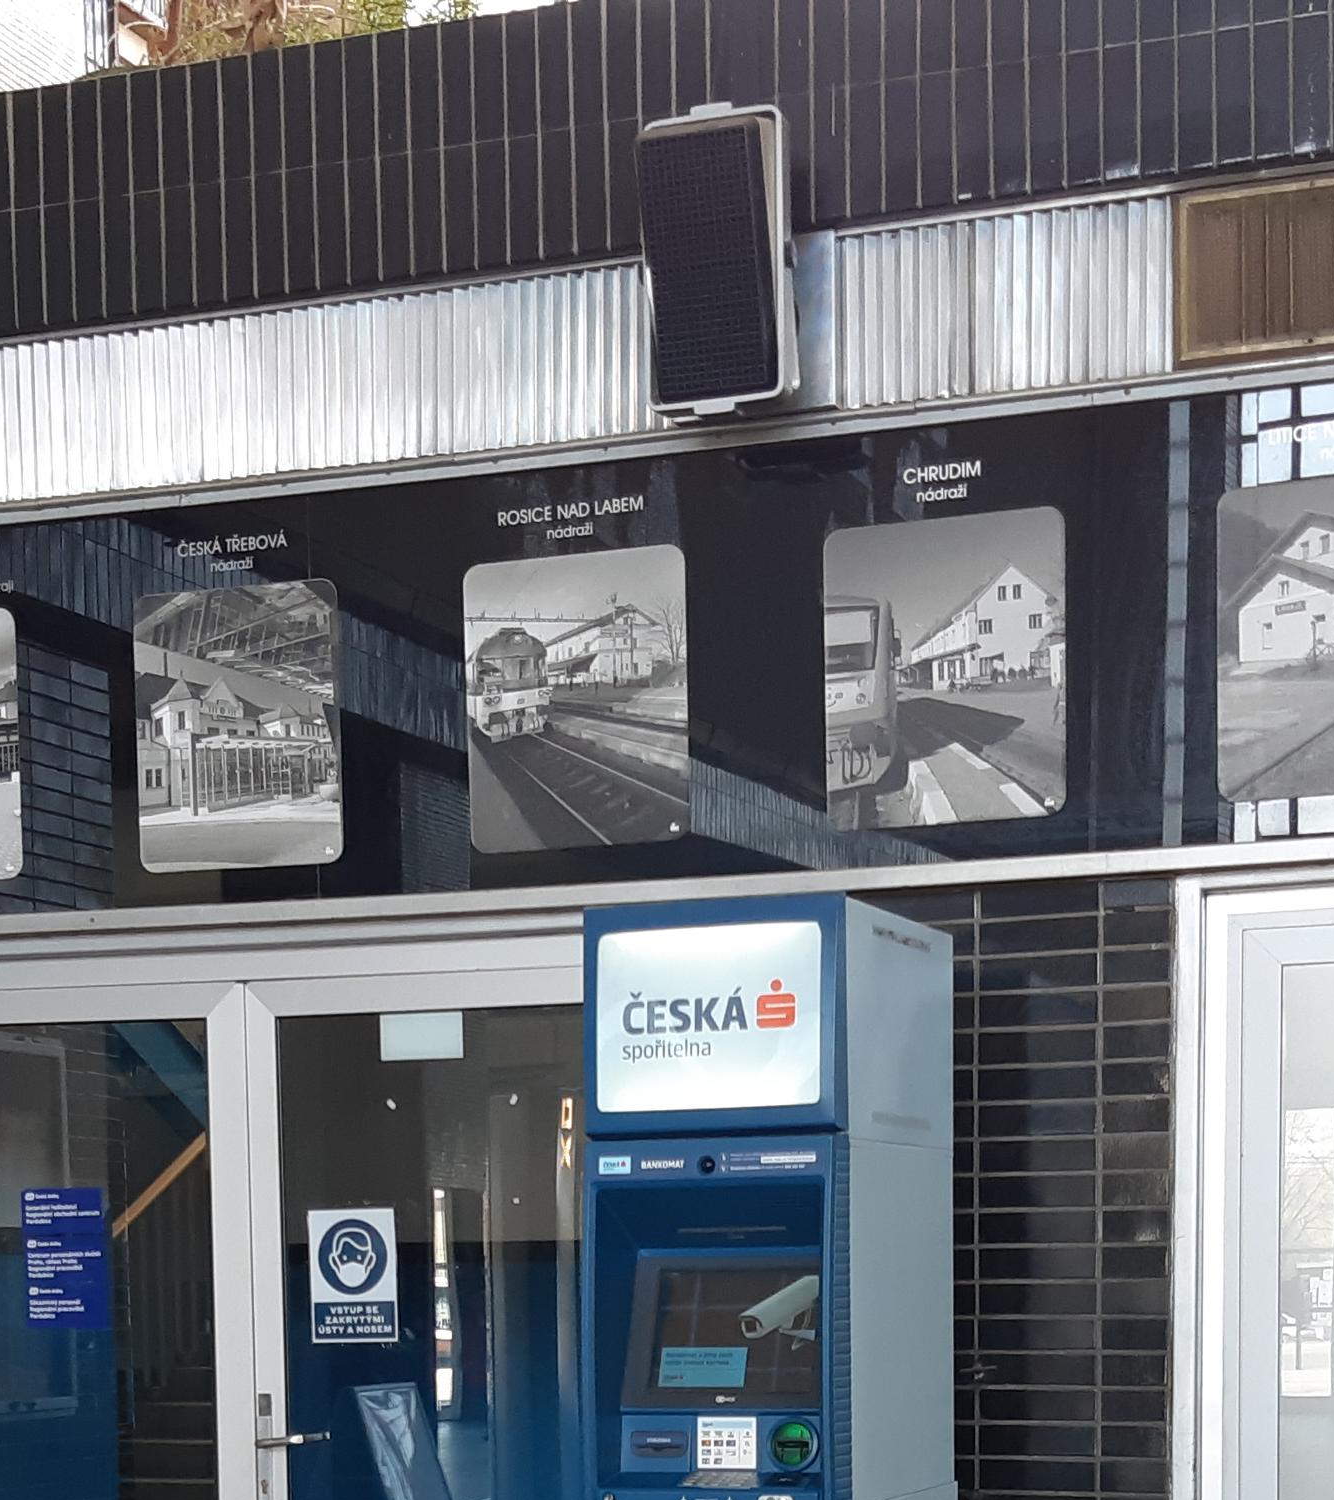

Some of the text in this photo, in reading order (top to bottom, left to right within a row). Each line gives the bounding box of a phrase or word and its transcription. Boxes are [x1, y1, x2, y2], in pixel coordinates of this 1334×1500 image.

[903, 460, 982, 485] CHRUDIM
[916, 482, 968, 503] nádraží
[497, 495, 644, 527] ROSICE NAD LABEM
[546, 521, 594, 540] nádraží
[177, 528, 288, 558] ČESKÁ TŘEBOVÁ
[210, 555, 255, 572] nádraží
[622, 986, 749, 1036] ČESKÁ
[622, 1038, 712, 1064] spořitelna
[640, 1159, 685, 1170] BANKOMAT
[324, 1314, 385, 1325] ZAKRYTÝMI
[329, 1304, 380, 1315] VSTUP SE
[317, 1324, 393, 1335] ÚSTY A NOSEM
